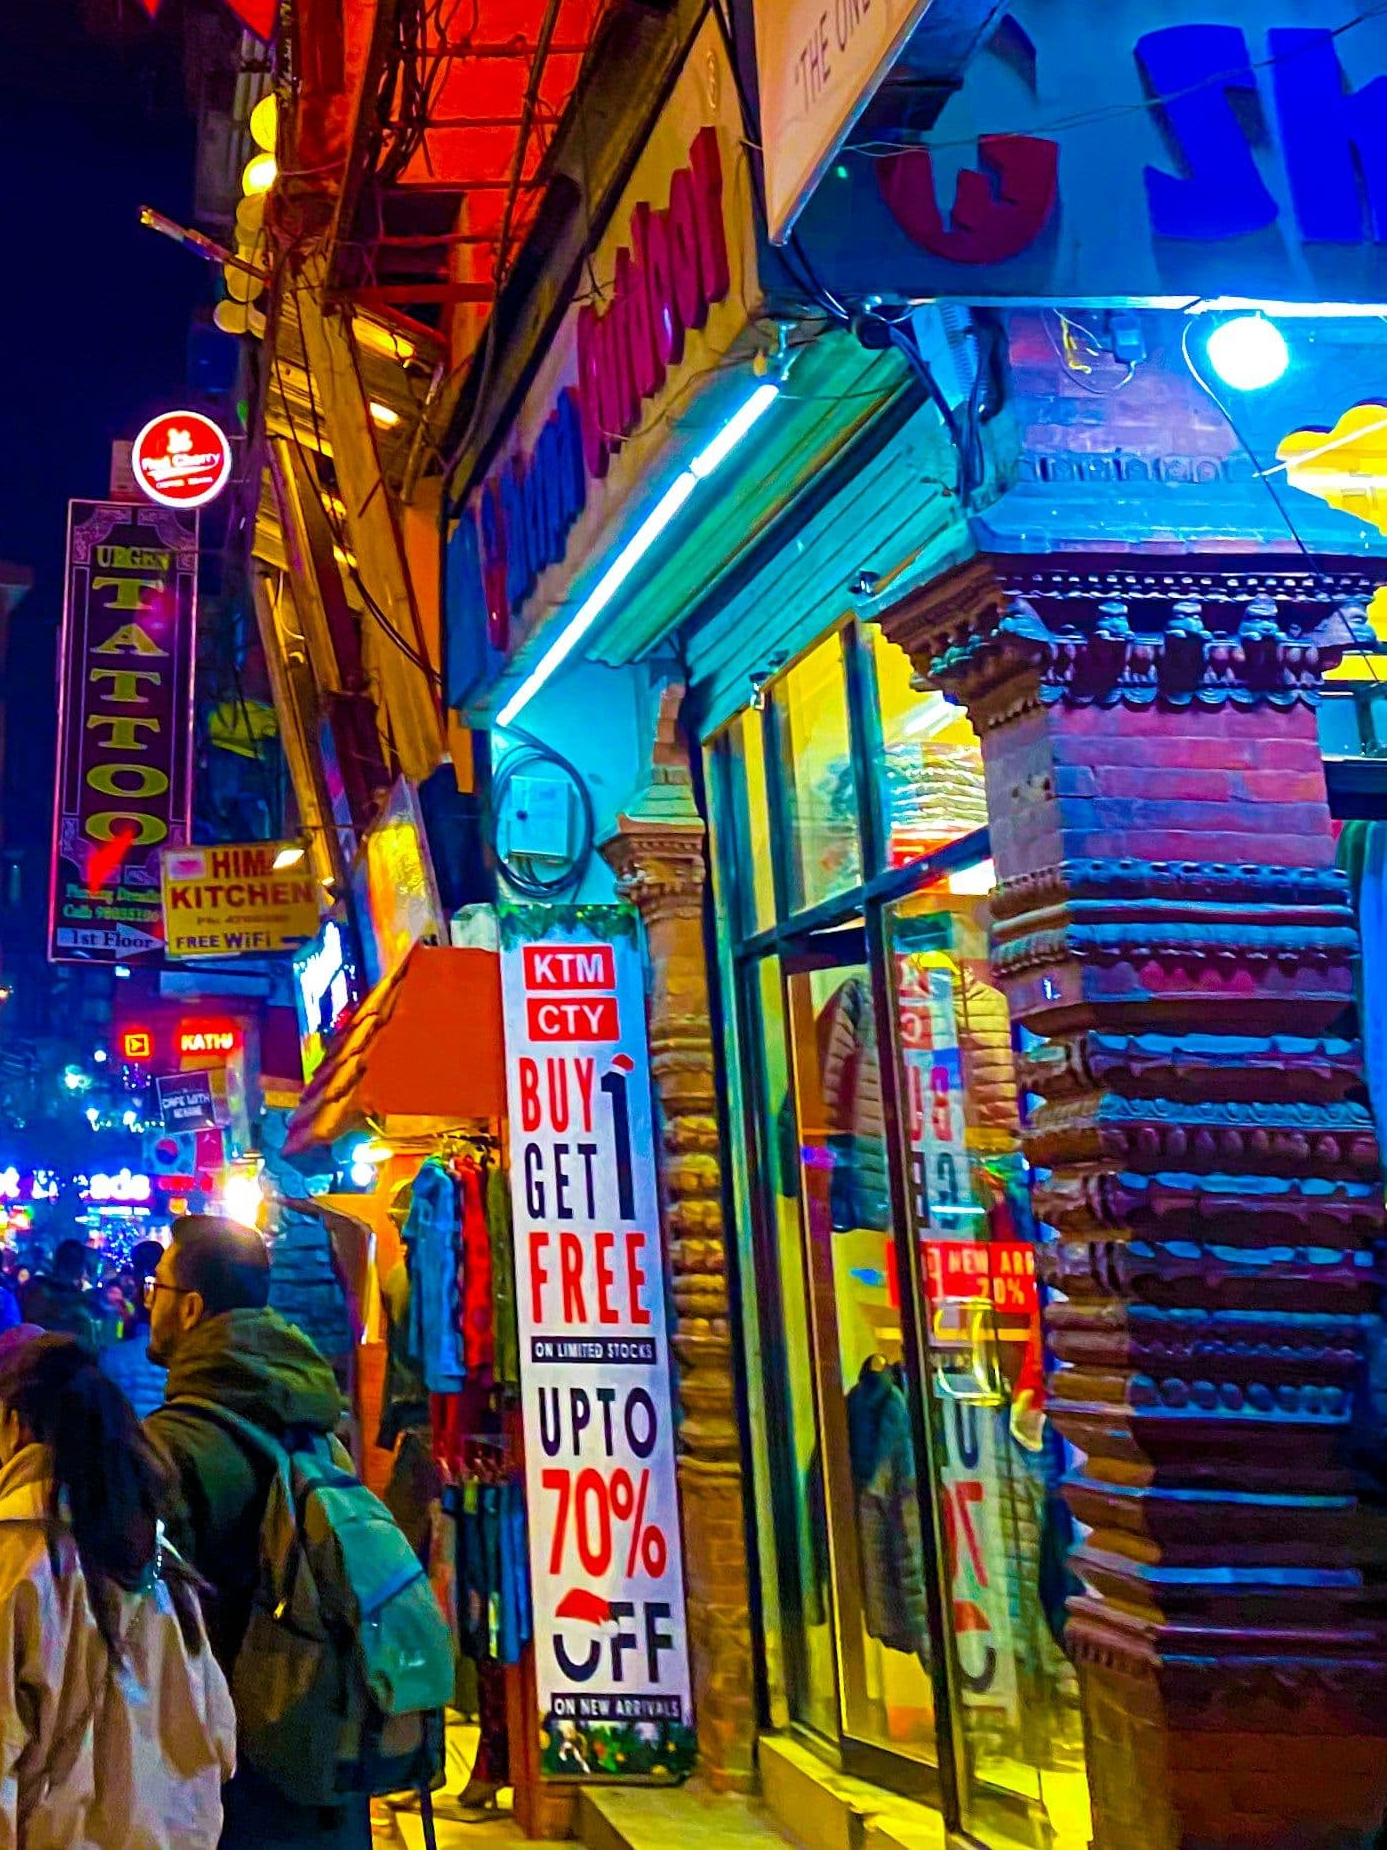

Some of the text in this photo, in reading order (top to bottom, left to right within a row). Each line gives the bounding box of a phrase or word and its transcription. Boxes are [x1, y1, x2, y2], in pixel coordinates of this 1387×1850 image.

[86, 576, 170, 845] TATTOO
[171, 884, 313, 910] KITCHEN
[71, 929, 154, 949] 1st Floor
[176, 932, 272, 950] FREE WiFi
[534, 952, 604, 983] KTM
[538, 1004, 603, 1034] CTY
[518, 1057, 595, 1133] BUY
[524, 1143, 598, 1221] GET
[529, 1232, 651, 1326] FREE
[534, 1341, 654, 1360] ON LIMITED STOCKS
[538, 1387, 658, 1458] UPTO
[542, 1467, 667, 1579] 70%
[554, 1697, 680, 1719] ON NEW ARRIVALS
